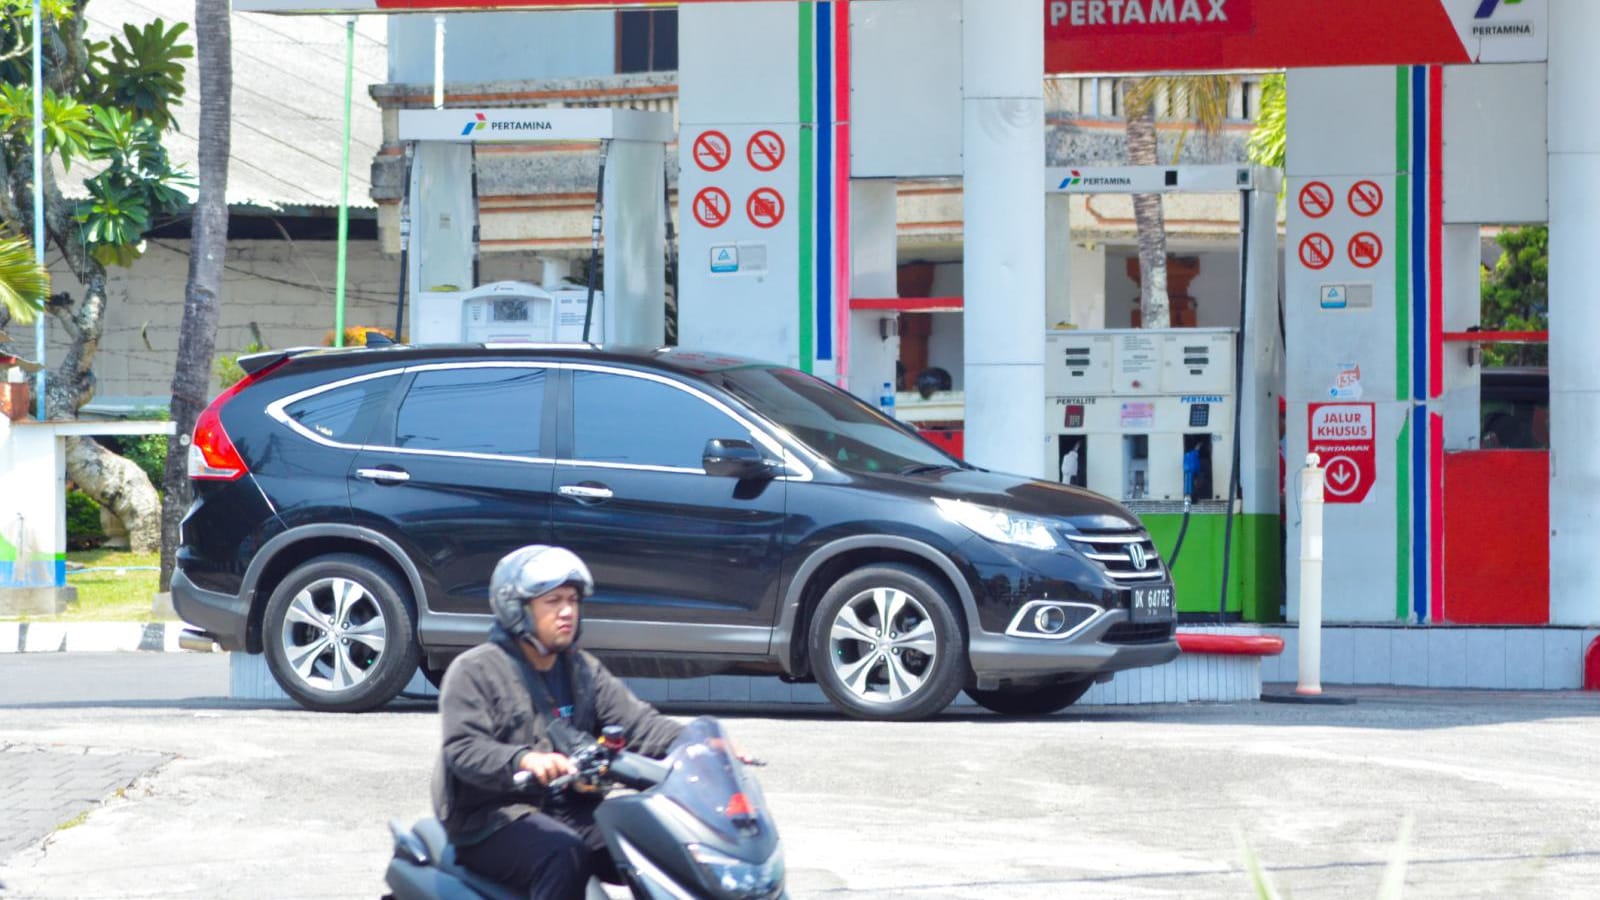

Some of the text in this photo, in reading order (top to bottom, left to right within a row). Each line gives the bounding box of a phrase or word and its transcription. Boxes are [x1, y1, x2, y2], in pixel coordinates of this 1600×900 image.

[1050, 0, 1228, 26] PERTAMAX
[1472, 25, 1531, 35] PERTAMINA
[491, 121, 552, 131] PERTAMINA
[1083, 177, 1131, 185] PERTAMINA
[1323, 413, 1362, 423] JALUR
[1317, 425, 1367, 436] KHUSUS
[1135, 589, 1144, 608] DK
